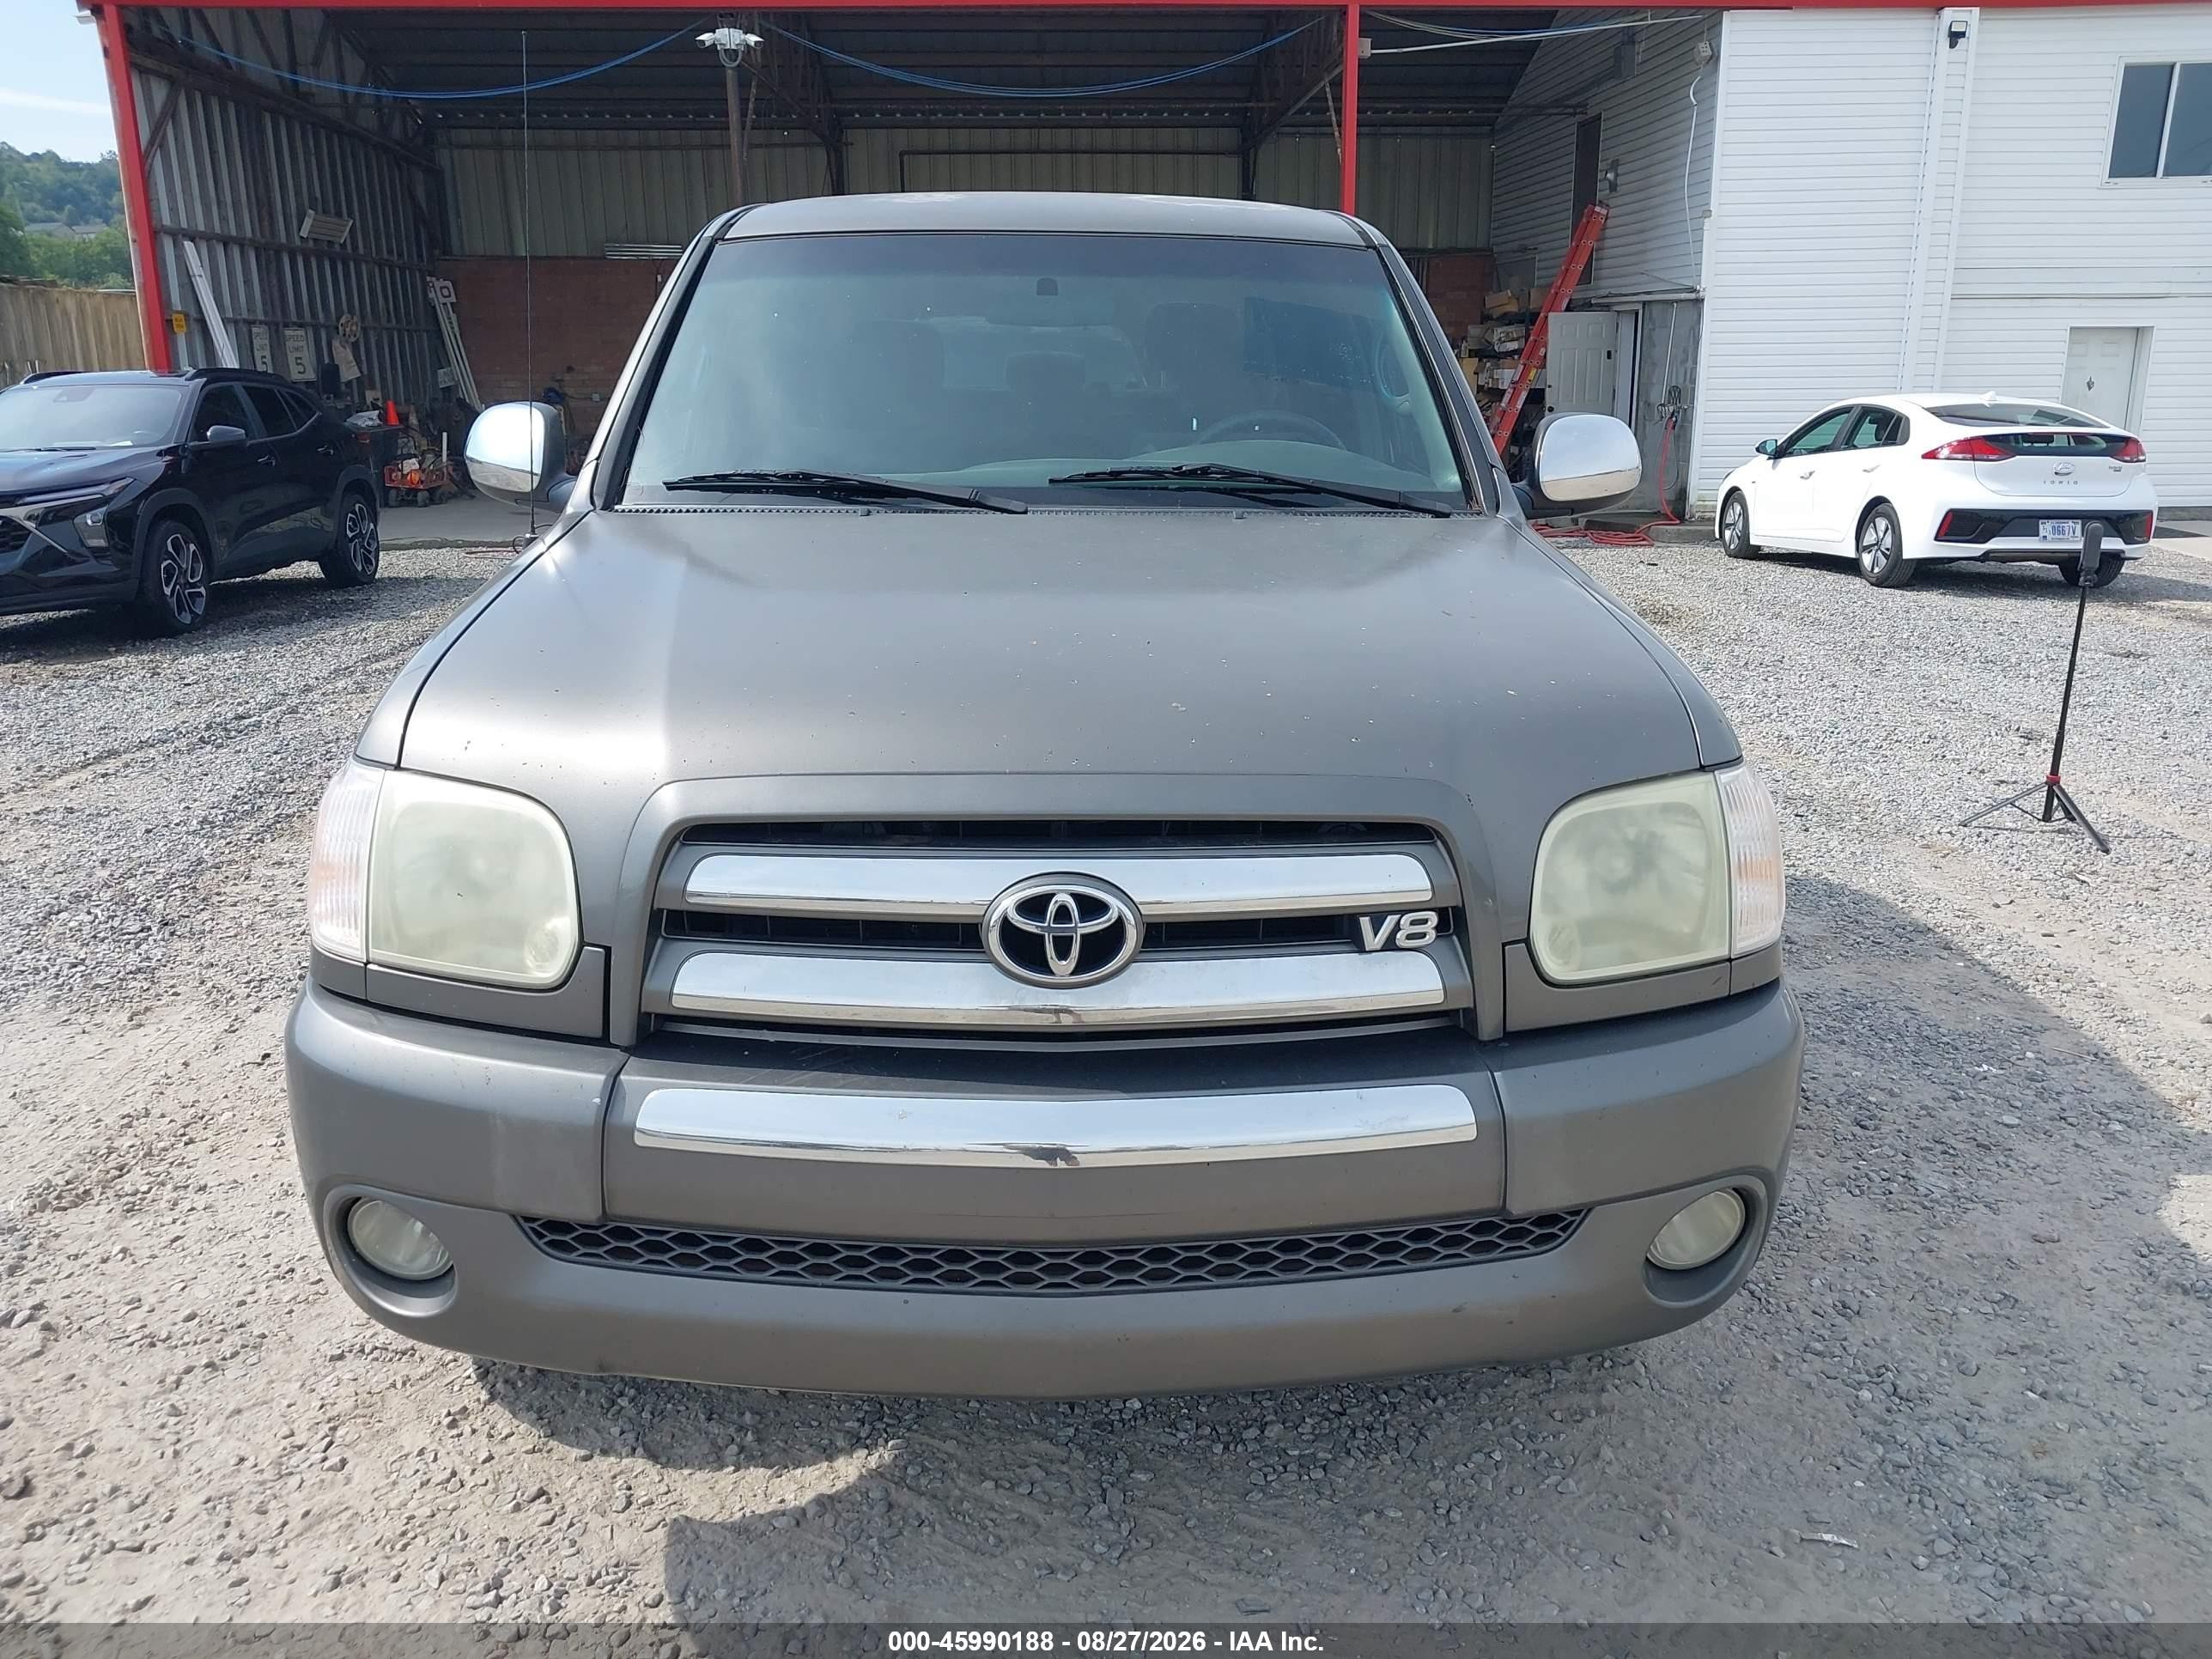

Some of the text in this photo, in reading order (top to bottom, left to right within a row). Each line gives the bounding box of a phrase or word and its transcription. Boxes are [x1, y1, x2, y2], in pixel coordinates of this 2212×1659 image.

[285, 334, 305, 343] SPEED
[295, 356, 307, 374] 5
[1359, 911, 1438, 951] V8
